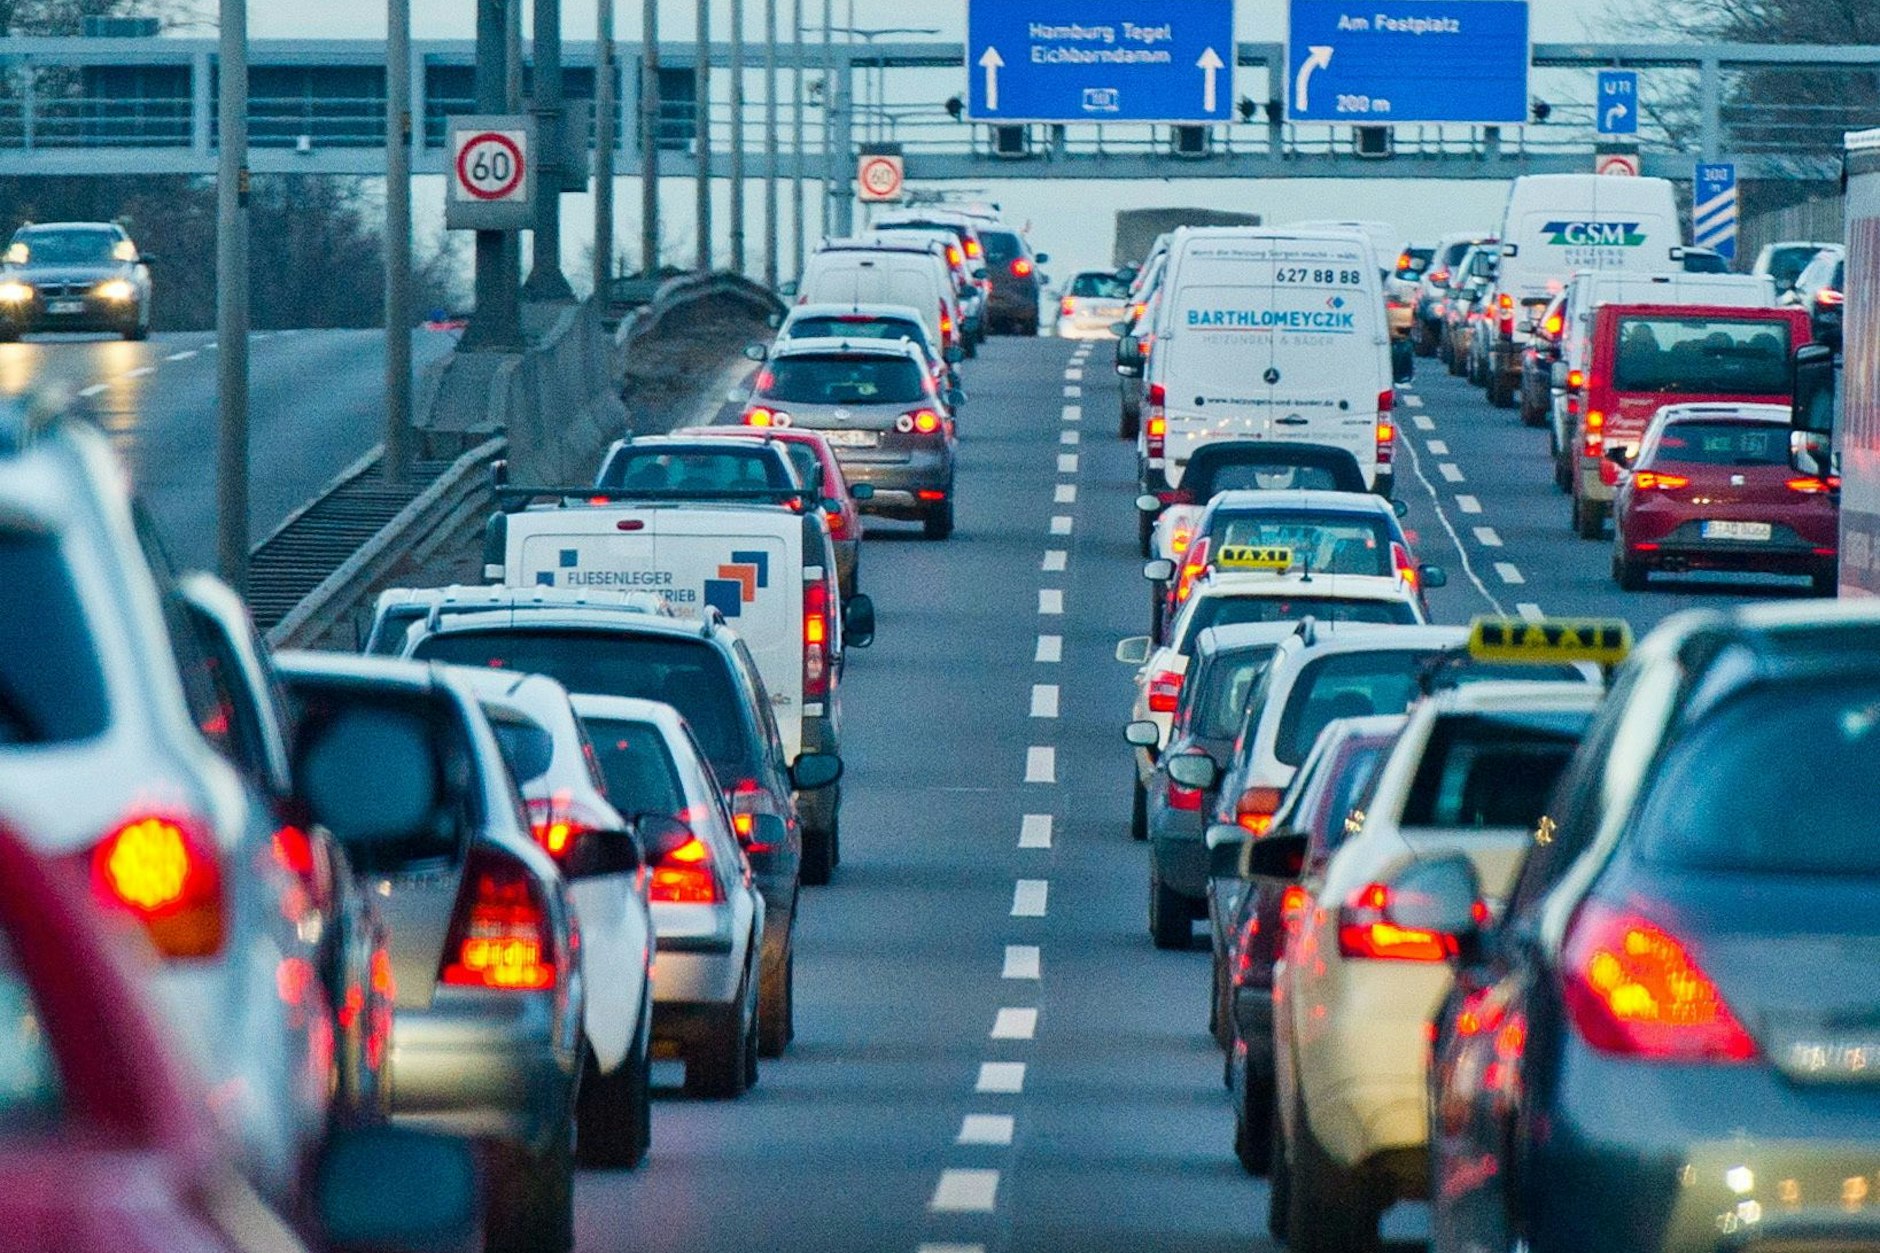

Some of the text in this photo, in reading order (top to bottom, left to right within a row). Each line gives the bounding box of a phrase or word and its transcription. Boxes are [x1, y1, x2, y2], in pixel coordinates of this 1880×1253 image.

[1028, 22, 1172, 44] Hamburg Tegel
[1337, 13, 1460, 35] Am Festplatz
[1336, 94, 1391, 112] 200 m
[472, 151, 510, 182] 60
[871, 168, 891, 186] 60
[1563, 222, 1626, 245] GSM
[1276, 268, 1361, 285] 627 88 88
[1187, 309, 1355, 328] BARTHLOMEYCZIK
[1229, 548, 1281, 562] TAXI
[567, 571, 673, 586] FLIESENLEGER
[1492, 621, 1607, 649] TAXI
